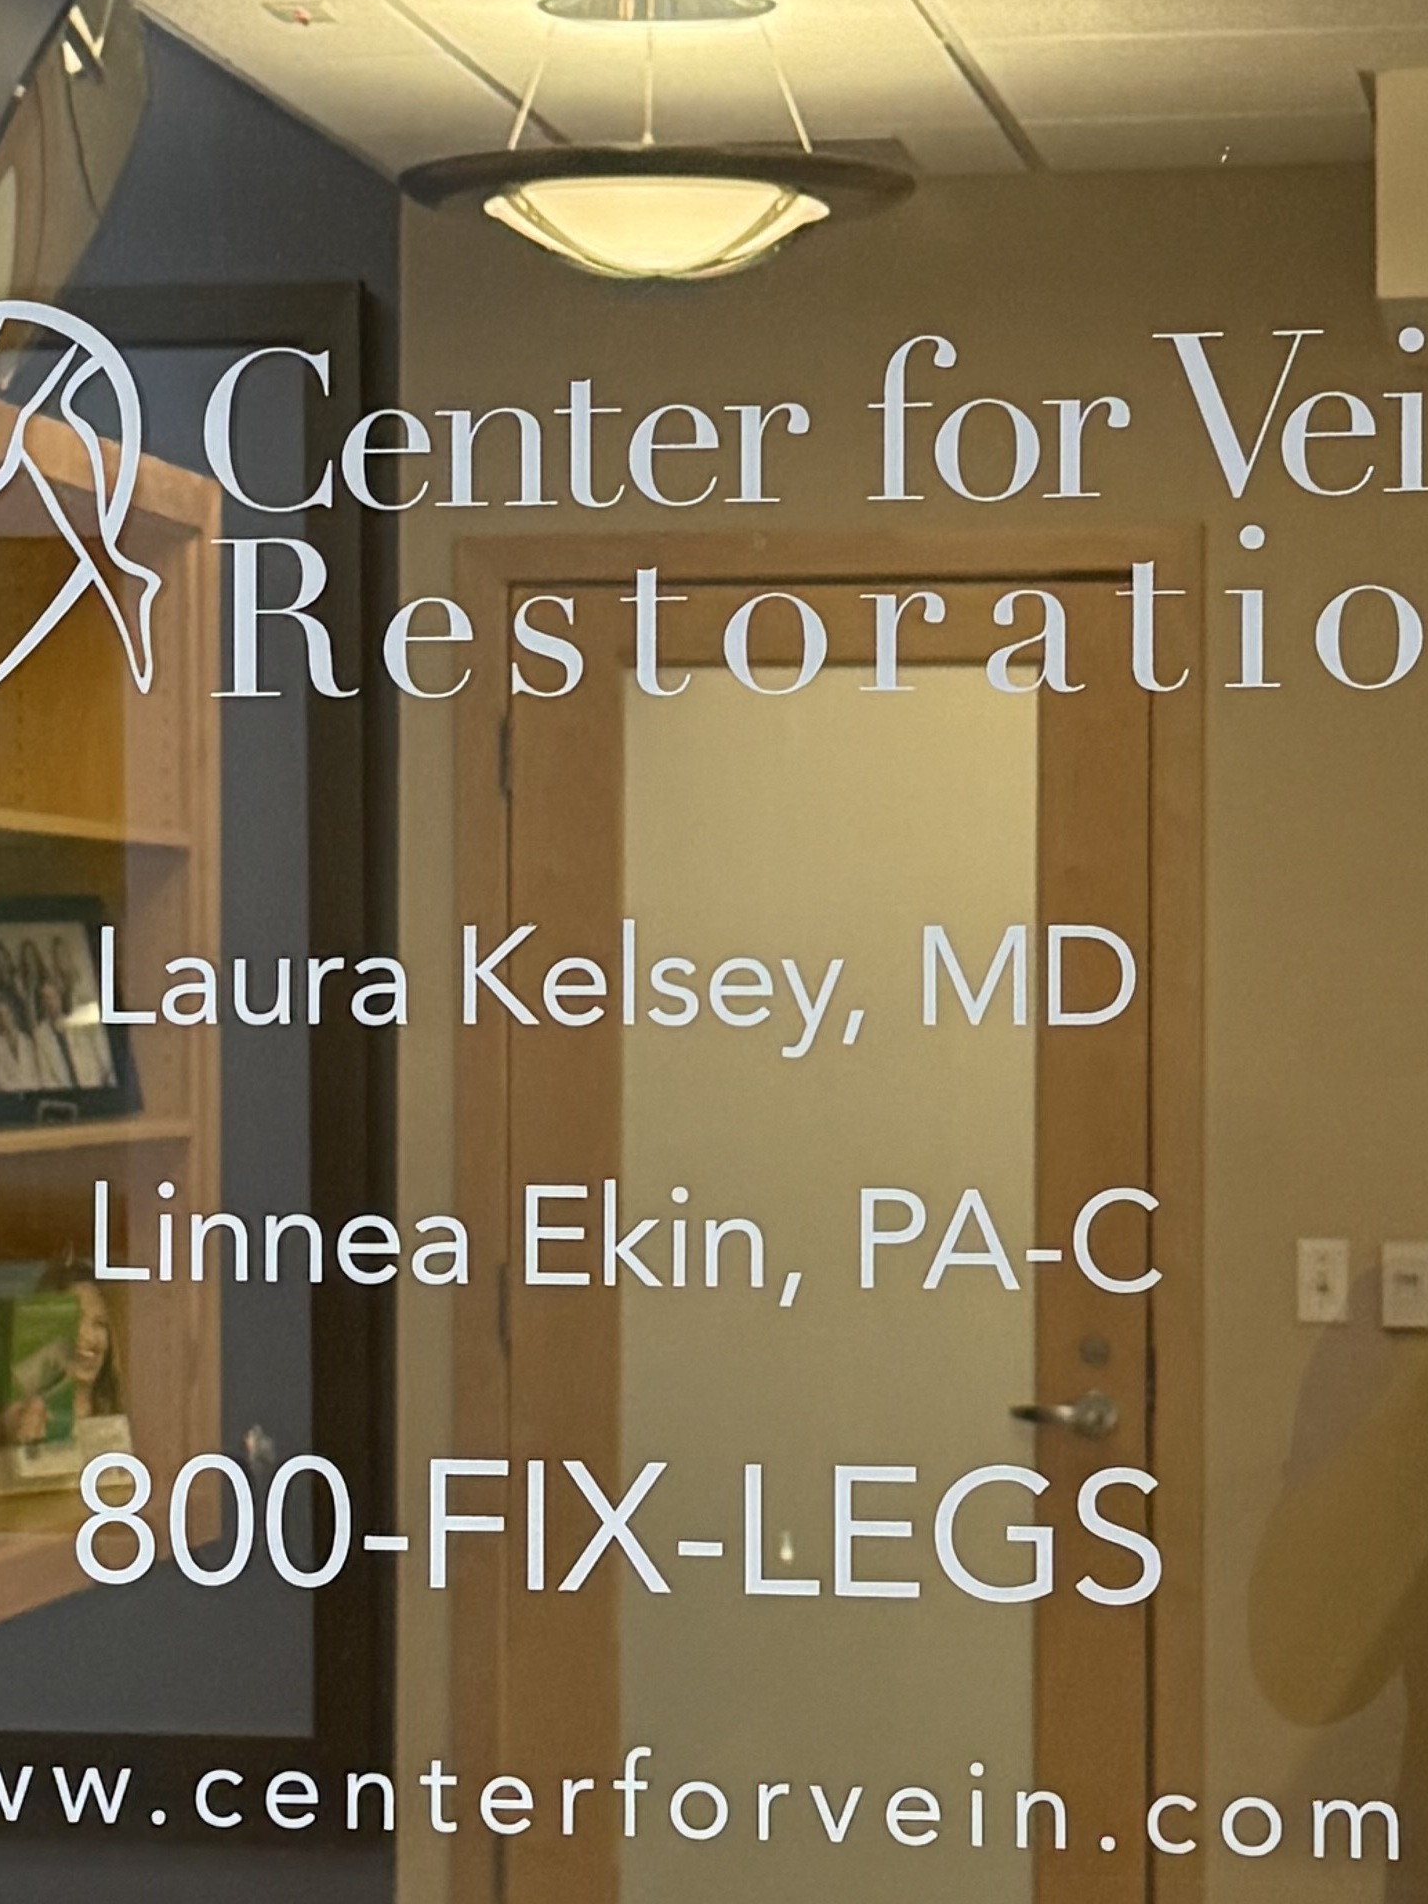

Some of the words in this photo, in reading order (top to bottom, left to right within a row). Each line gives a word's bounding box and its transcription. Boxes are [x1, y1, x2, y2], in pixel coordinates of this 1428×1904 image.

[202, 346, 810, 514] Center
[866, 334, 1130, 502] for
[100, 924, 410, 1027] Laura
[462, 919, 867, 1057] Kelsey,
[921, 925, 1137, 1026] MD
[92, 1180, 470, 1287] Linnea
[524, 1180, 801, 1308] Ekin,
[860, 1187, 1163, 1294] PA-C
[73, 1452, 1164, 1606] 800-FIX-LEGS
